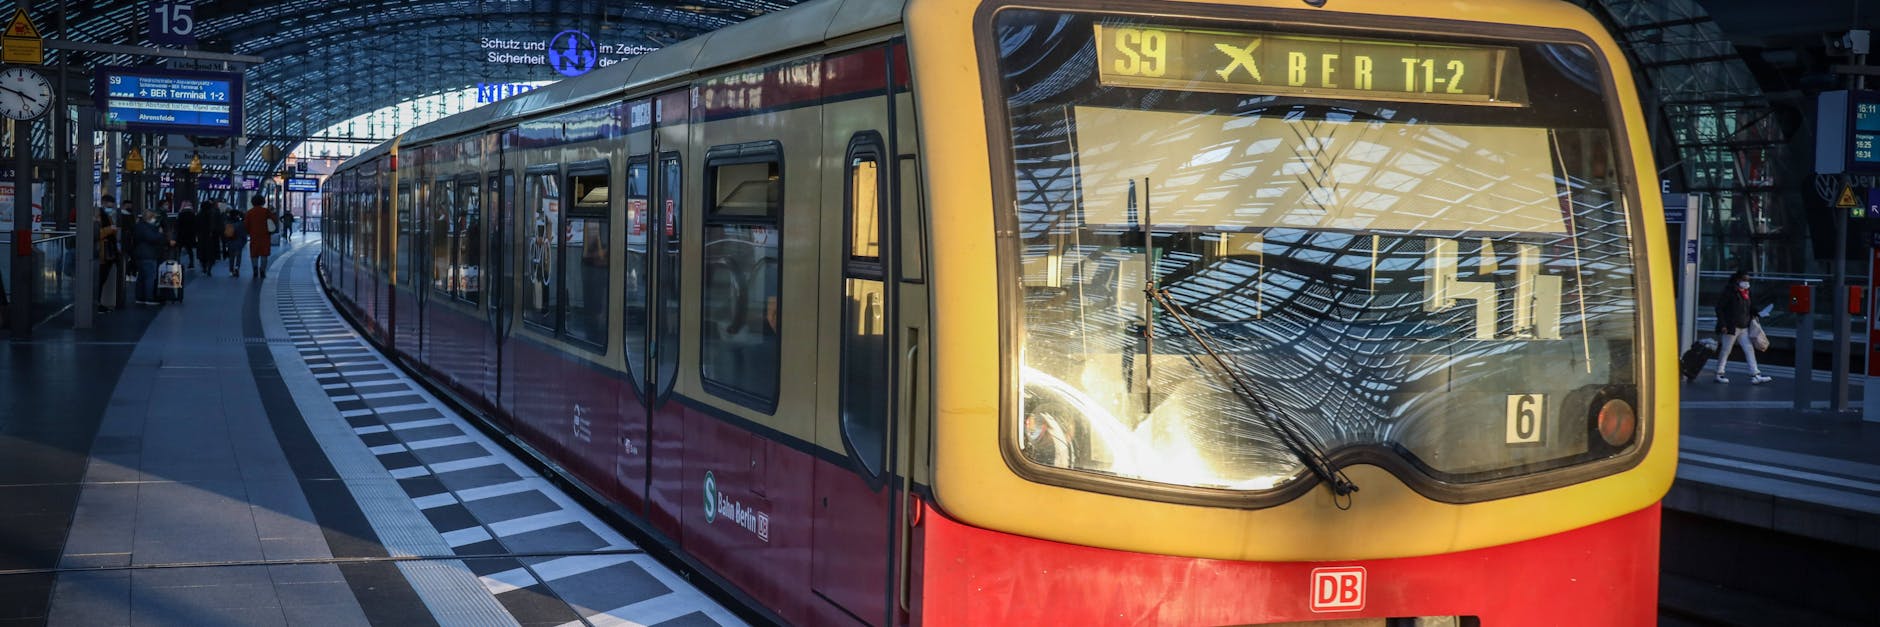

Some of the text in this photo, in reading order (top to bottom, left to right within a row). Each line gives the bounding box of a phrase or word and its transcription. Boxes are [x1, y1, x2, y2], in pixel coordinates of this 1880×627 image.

[155, 4, 193, 35] 15
[481, 37, 546, 51] Schutz und
[599, 43, 613, 54] im
[487, 51, 545, 65] Sicherheit
[1114, 29, 1465, 94] S9 BER T1-2
[109, 76, 122, 85] S9
[150, 88, 225, 101] BER Terminal 1-2
[1661, 179, 1671, 194] E
[1515, 394, 1536, 440] 6
[705, 477, 714, 518] S
[717, 491, 735, 521] Bahn
[735, 500, 757, 533] Berlin
[1317, 574, 1359, 605] DB
